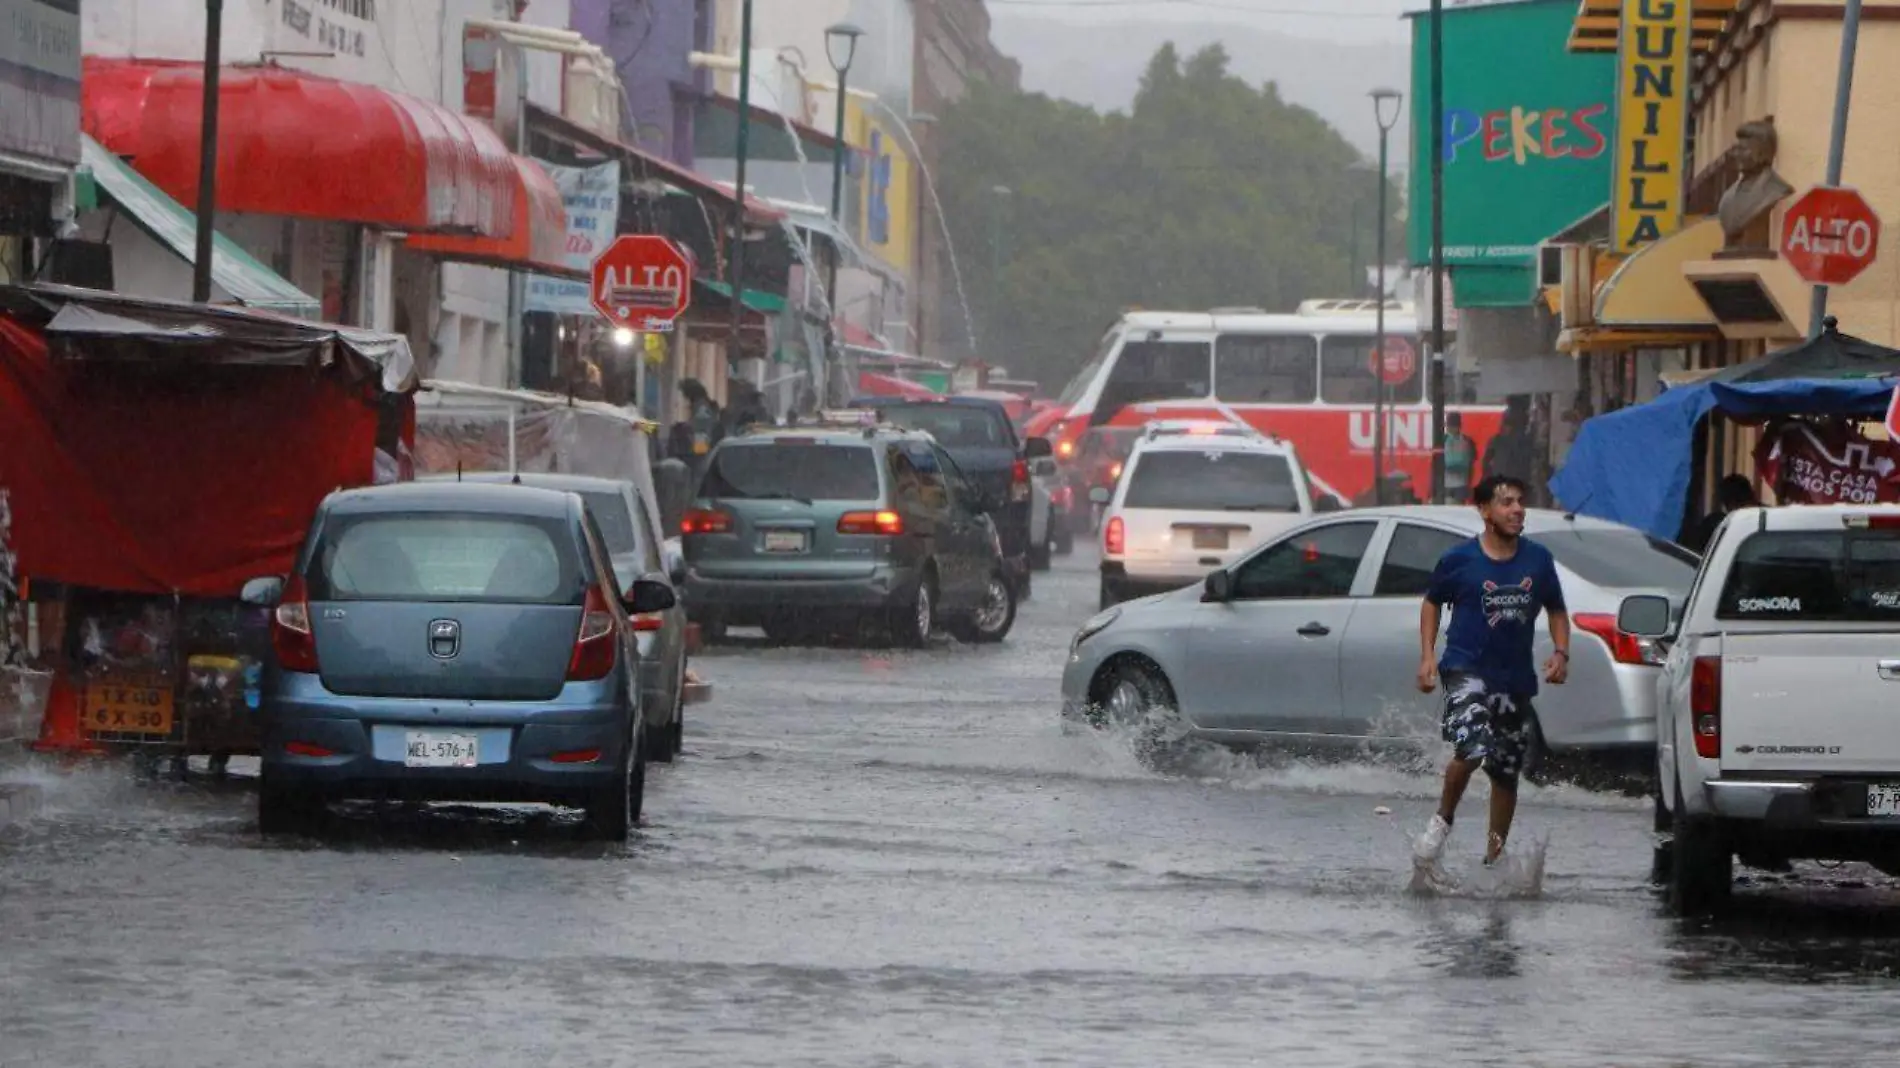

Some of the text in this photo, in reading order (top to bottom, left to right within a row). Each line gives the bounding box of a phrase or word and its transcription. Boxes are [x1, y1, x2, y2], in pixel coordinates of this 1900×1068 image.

[1442, 103, 1607, 165] PEKES
[1787, 215, 1872, 258] ALTO
[601, 264, 683, 305] ALTO
[1830, 469, 1877, 492] CASA
[1839, 485, 1877, 505] POR
[1738, 596, 1801, 613] SONORA
[1757, 745, 1842, 754] COLORADO LT
